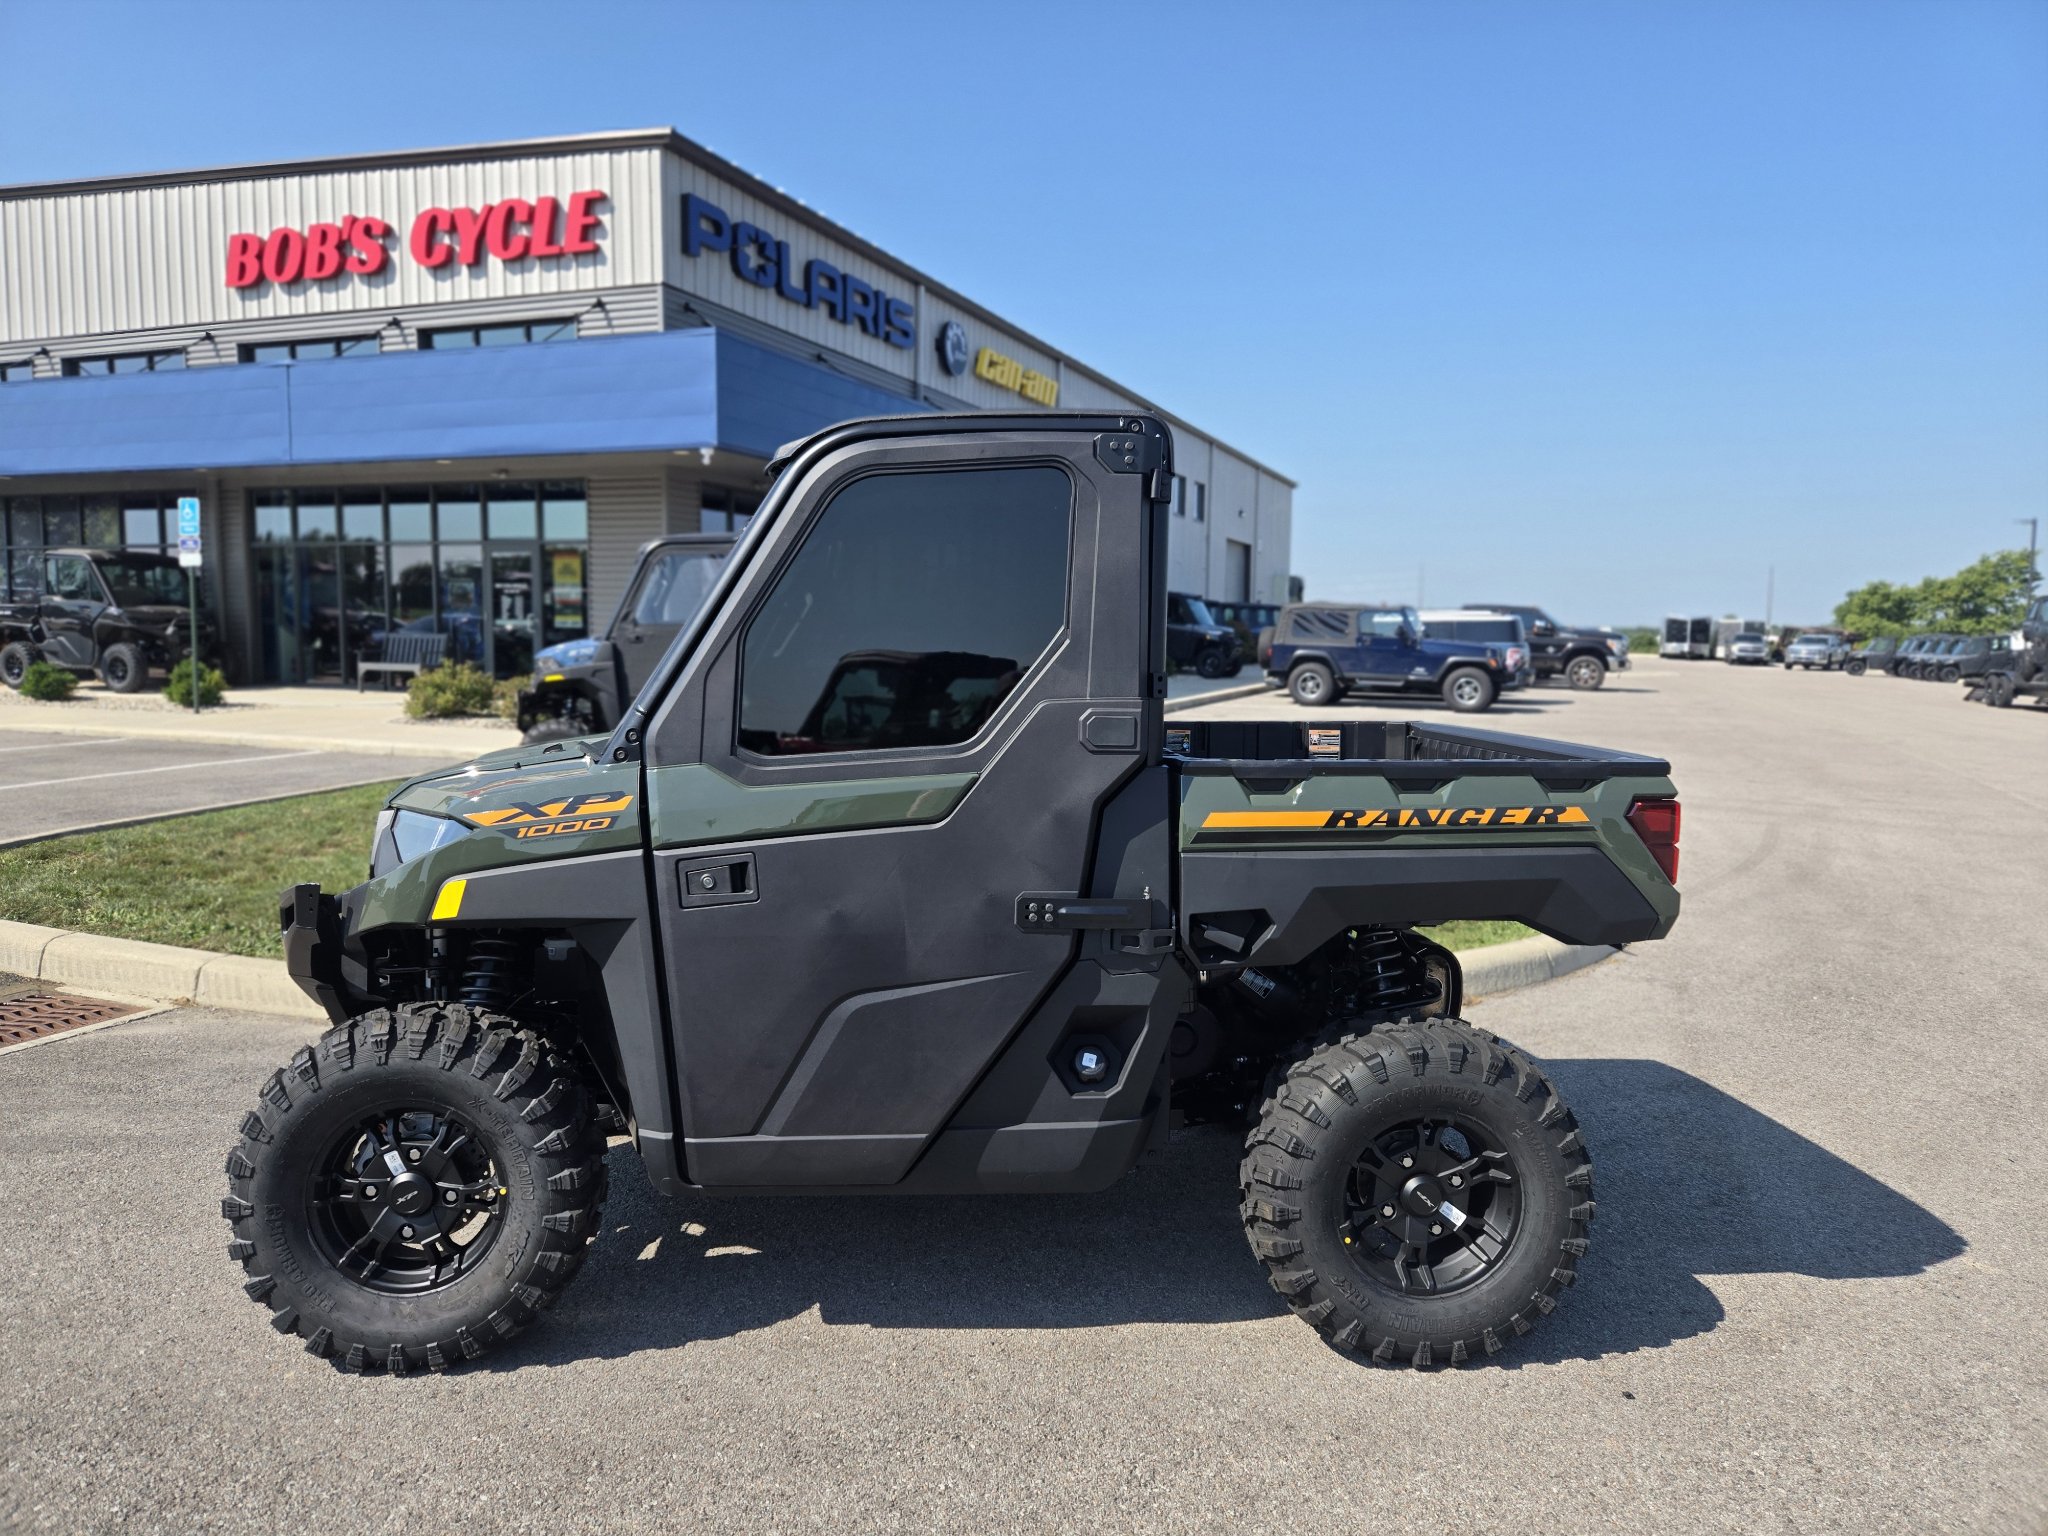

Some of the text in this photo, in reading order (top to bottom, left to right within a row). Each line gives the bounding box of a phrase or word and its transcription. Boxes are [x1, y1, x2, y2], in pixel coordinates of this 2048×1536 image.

[226, 190, 608, 288] BOB'S CYCLE
[682, 193, 917, 350] POLARIS
[492, 790, 628, 824] XP
[516, 818, 612, 839] 1000
[1323, 806, 1569, 829] RANGER
[465, 1096, 535, 1200] X-TERRAIN
